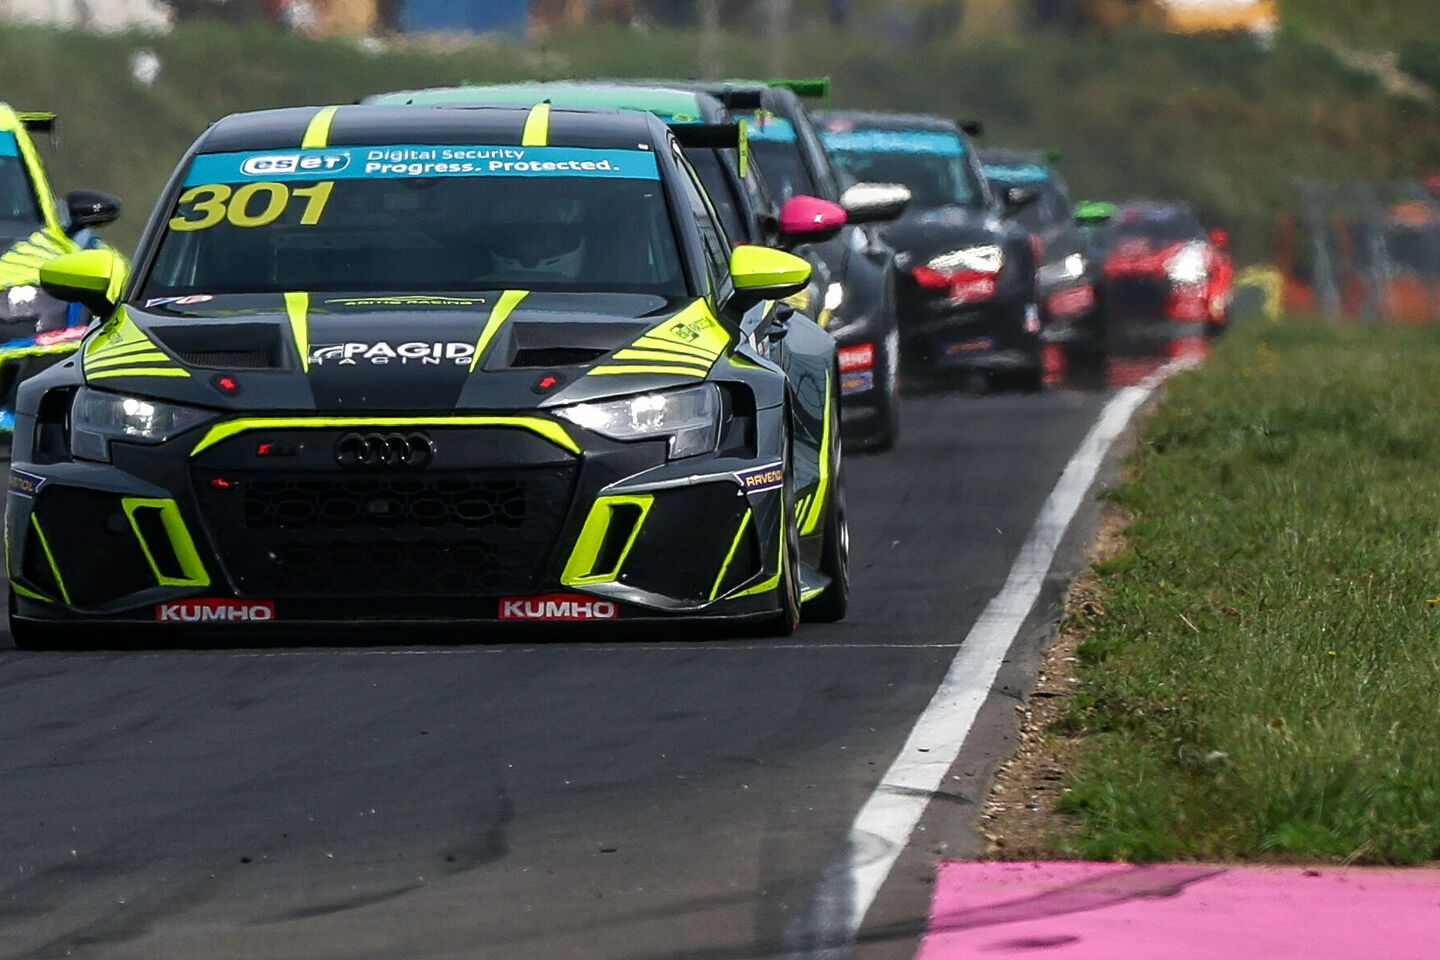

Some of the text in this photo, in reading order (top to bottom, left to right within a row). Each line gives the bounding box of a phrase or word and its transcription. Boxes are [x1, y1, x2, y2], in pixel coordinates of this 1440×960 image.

[367, 147, 525, 163] Digital Security
[365, 158, 621, 175] Progress. Protected.
[168, 181, 335, 232] 301
[343, 341, 476, 359] PAGID
[160, 604, 272, 621] KUMHO
[503, 600, 616, 619] KUMHO
